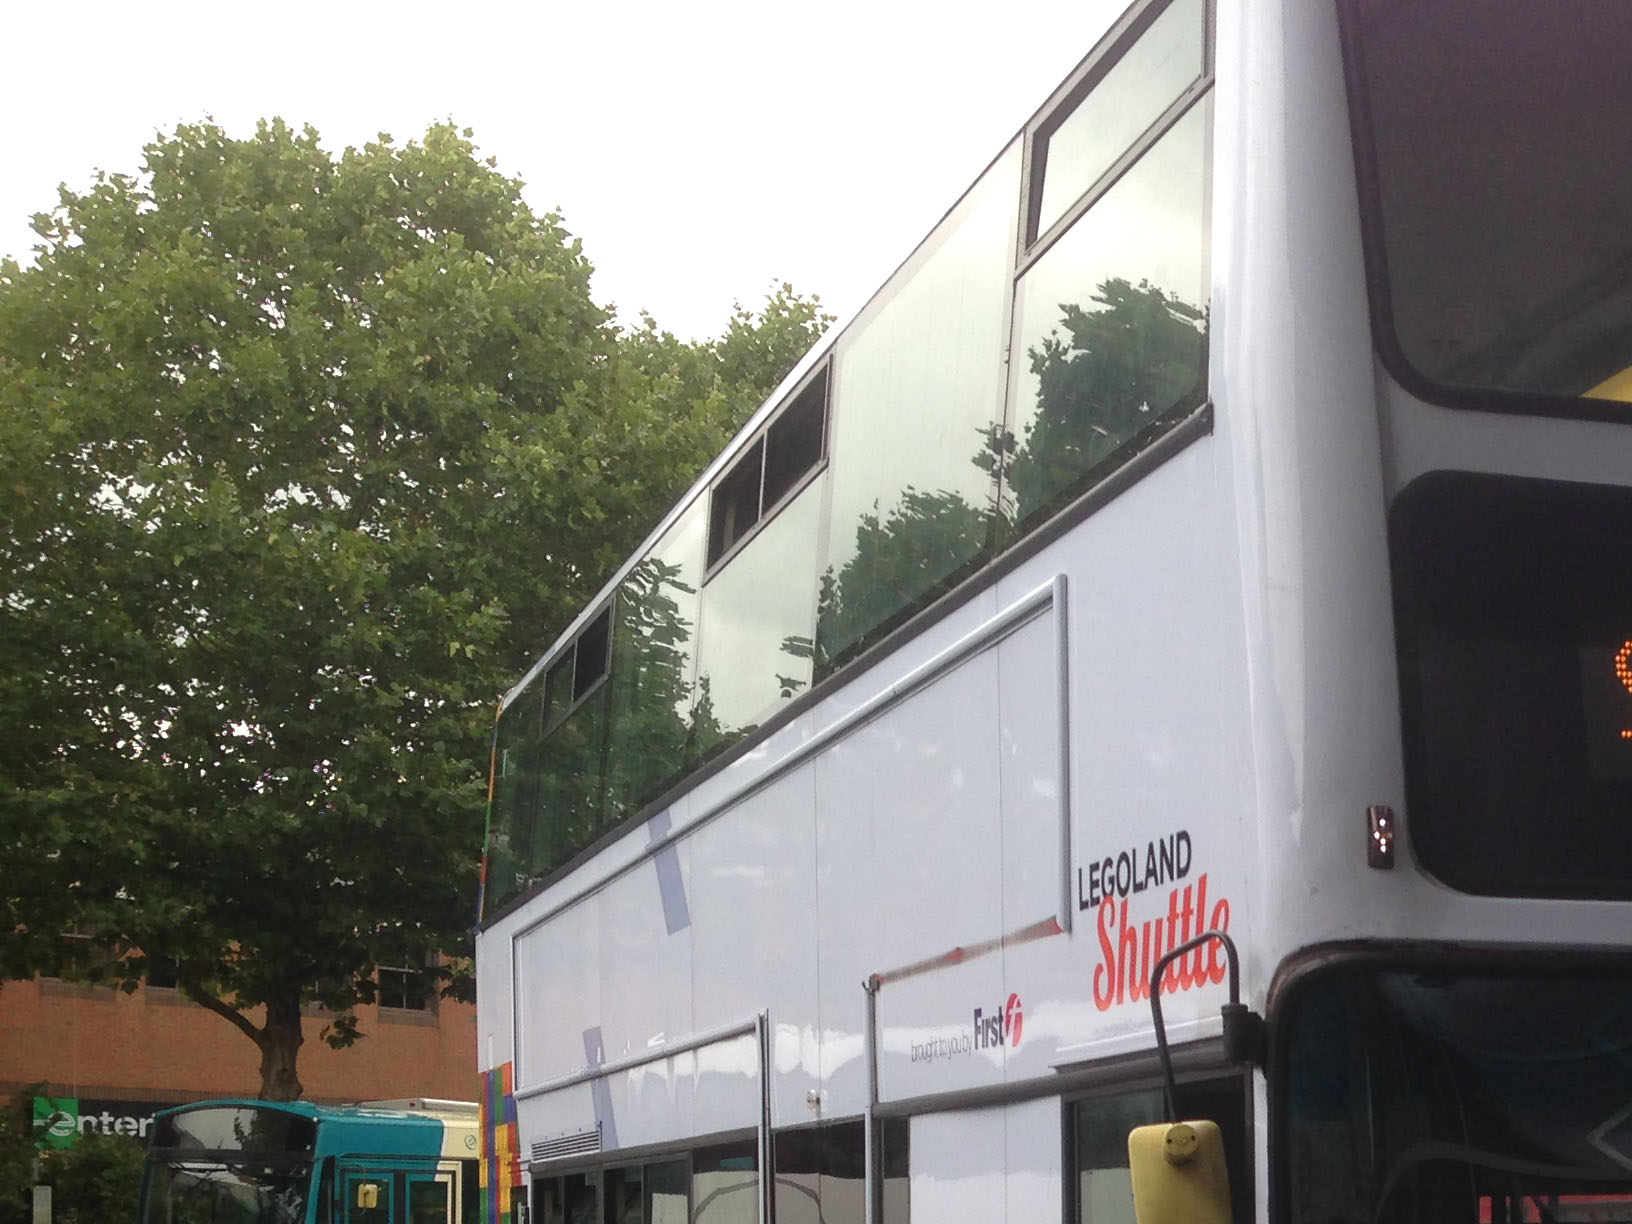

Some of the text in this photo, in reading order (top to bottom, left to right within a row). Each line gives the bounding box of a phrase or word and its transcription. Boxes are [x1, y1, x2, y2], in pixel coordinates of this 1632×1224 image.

[1078, 830, 1192, 911] LEGOLAND
[1093, 872, 1230, 1012] Shuttle
[974, 1005, 1004, 1050] First
